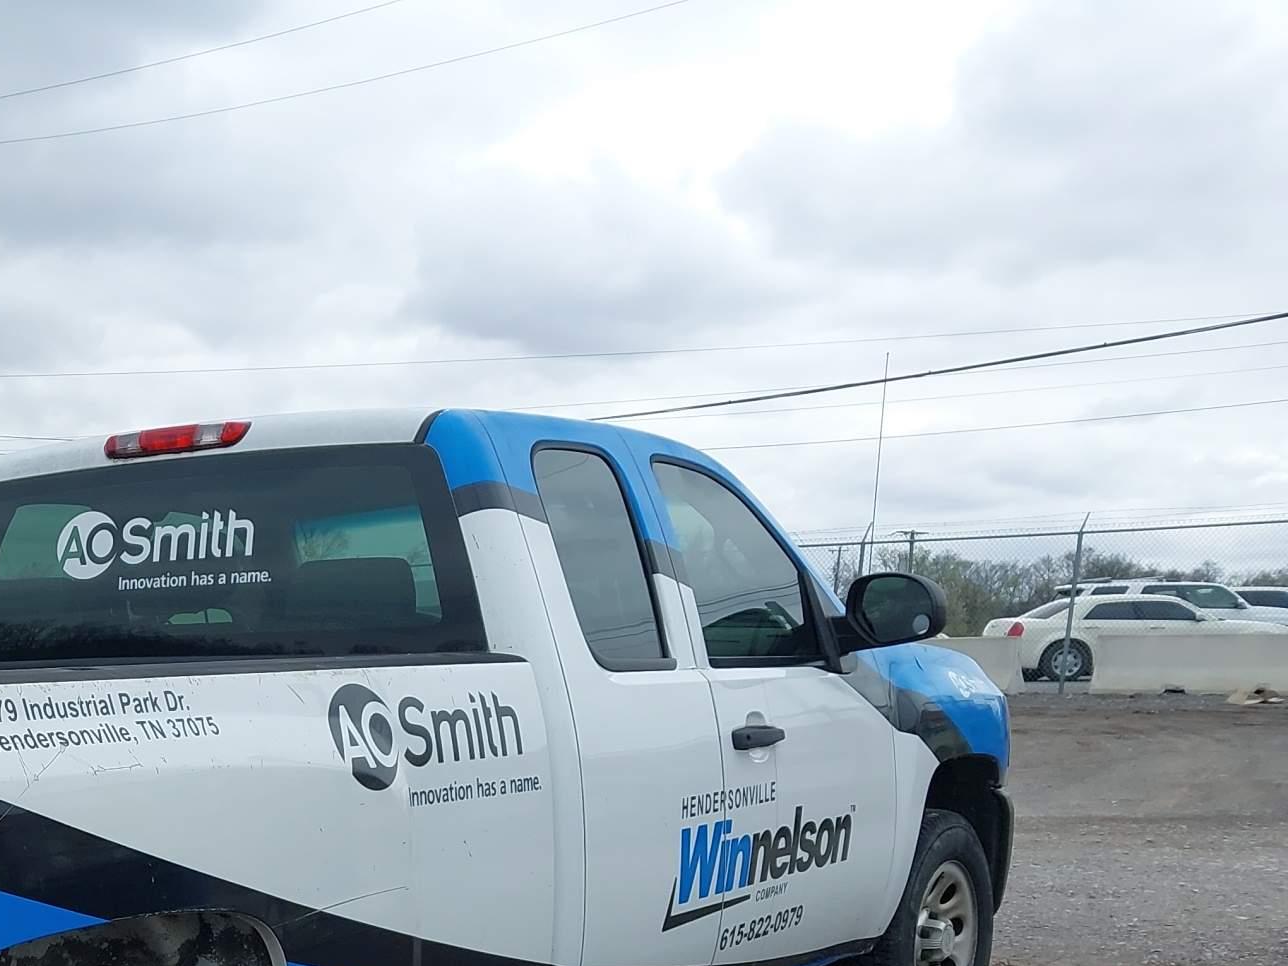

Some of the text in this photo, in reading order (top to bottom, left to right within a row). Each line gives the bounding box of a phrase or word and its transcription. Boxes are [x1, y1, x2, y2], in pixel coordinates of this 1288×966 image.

[118, 569, 272, 591] Innovation has a name.
[22, 693, 116, 721] Industrial
[118, 690, 161, 715] Park
[163, 689, 191, 713] Dr.
[136, 718, 167, 741] TN
[166, 716, 220, 738] 37075
[408, 774, 542, 808] Innovation has a name.
[681, 781, 776, 820] HENDERSONVILLE
[678, 805, 853, 905] Winnelson
[755, 882, 788, 901] COMPANY
[719, 904, 804, 951] 615-822-0979
